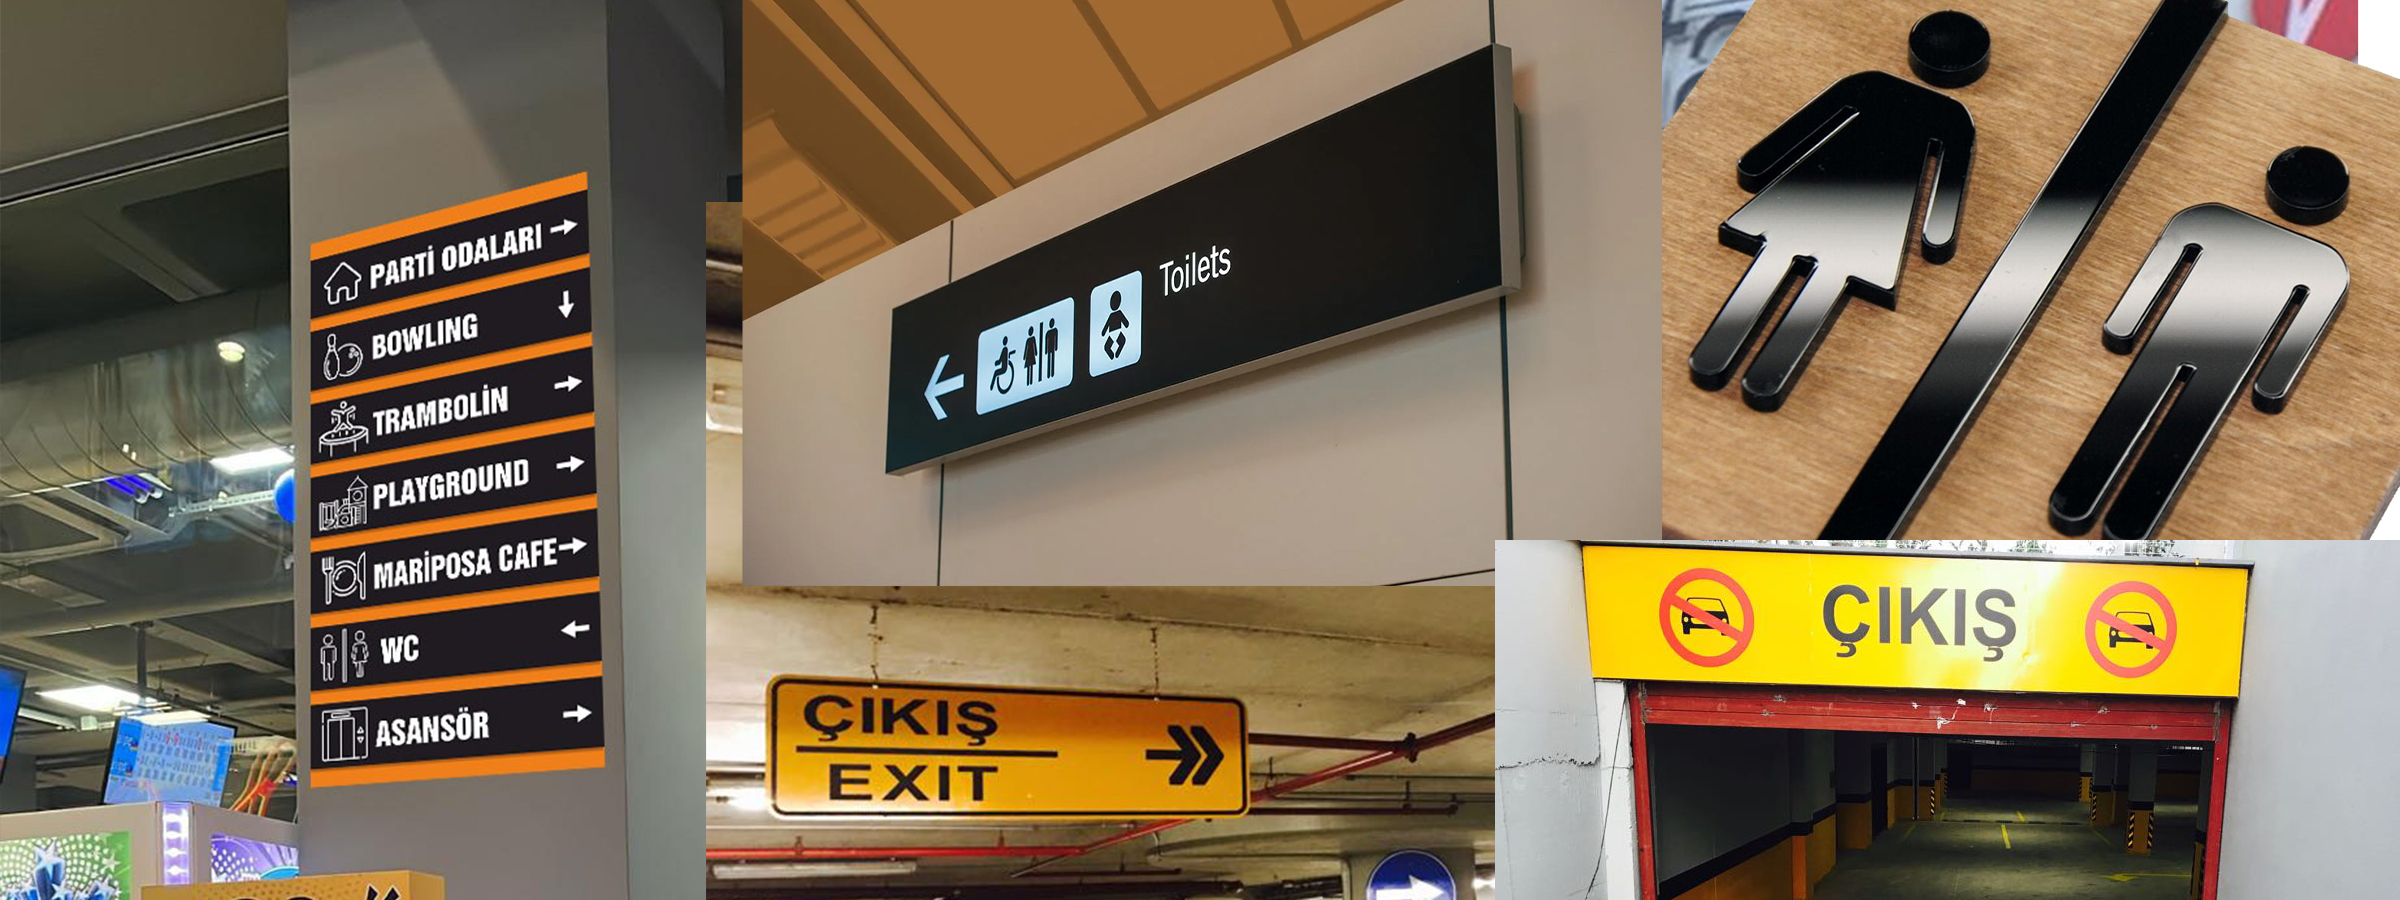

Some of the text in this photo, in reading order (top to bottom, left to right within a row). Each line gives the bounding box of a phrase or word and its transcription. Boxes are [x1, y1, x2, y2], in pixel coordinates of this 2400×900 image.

[370, 223, 542, 290] PARTİ ODALARI
[1159, 245, 1231, 297] Toilets
[372, 313, 478, 360] BOWLING
[373, 384, 509, 436] TRAMBOLİN
[373, 459, 529, 510] PLAYGROUND
[373, 537, 558, 590] MARİPOSA CAFE
[380, 634, 419, 664] WC
[1823, 584, 2017, 662] ÇIKIŞ
[375, 706, 489, 748] ASANSÖR
[803, 694, 998, 746] ÇIKIŞ
[829, 763, 998, 801] EXIT
